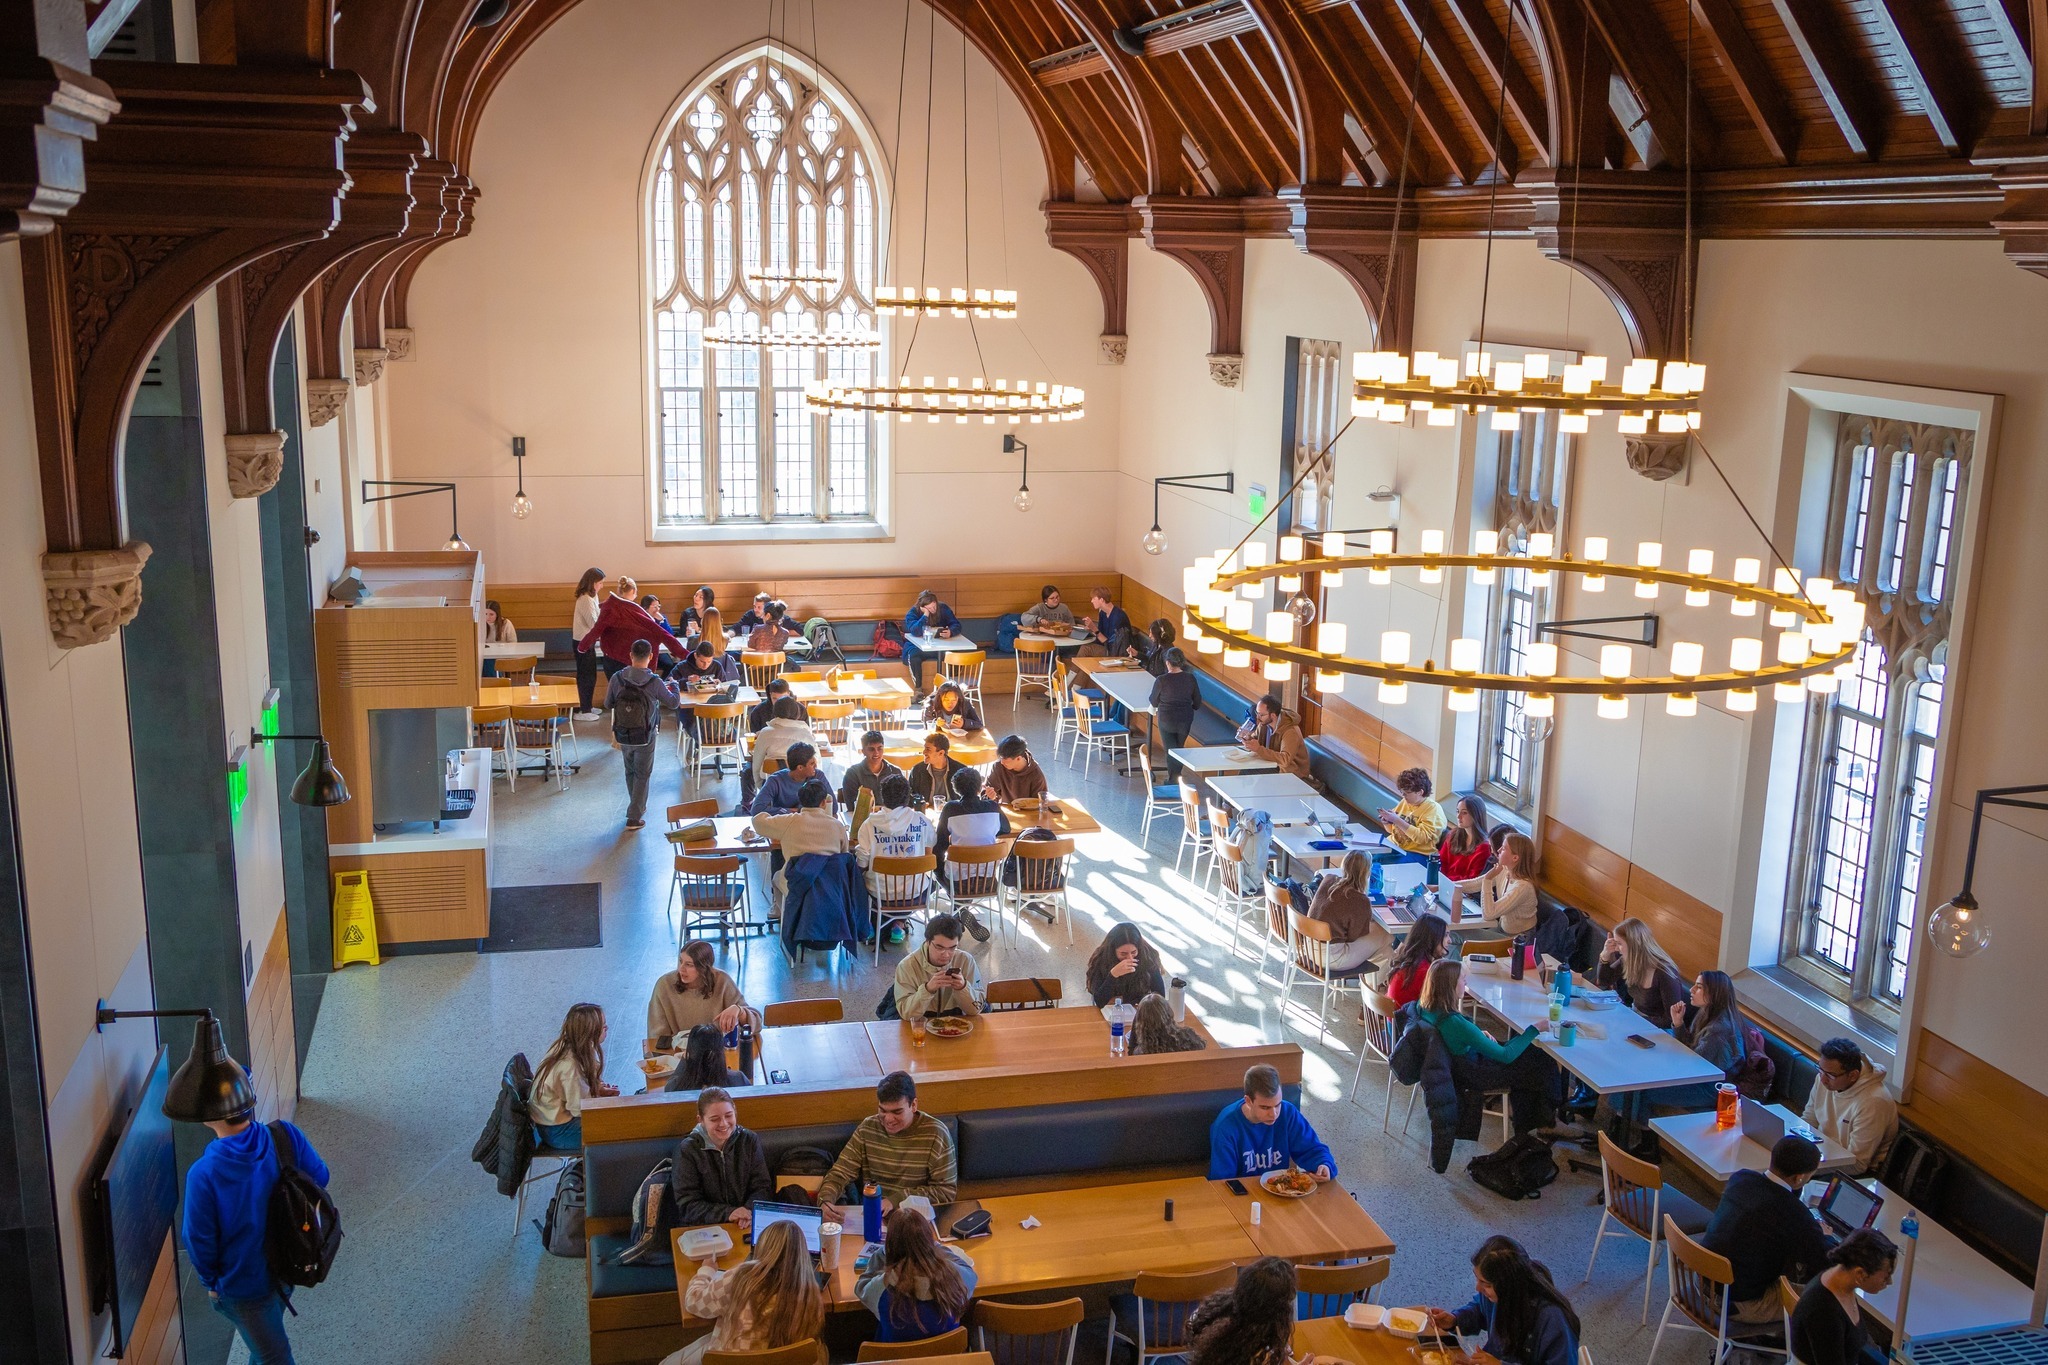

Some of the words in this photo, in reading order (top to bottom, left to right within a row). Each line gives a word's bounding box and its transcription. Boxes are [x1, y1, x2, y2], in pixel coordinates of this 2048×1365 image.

[906, 824, 922, 833] hat
[874, 834, 890, 844] You
[915, 833, 921, 842] It
